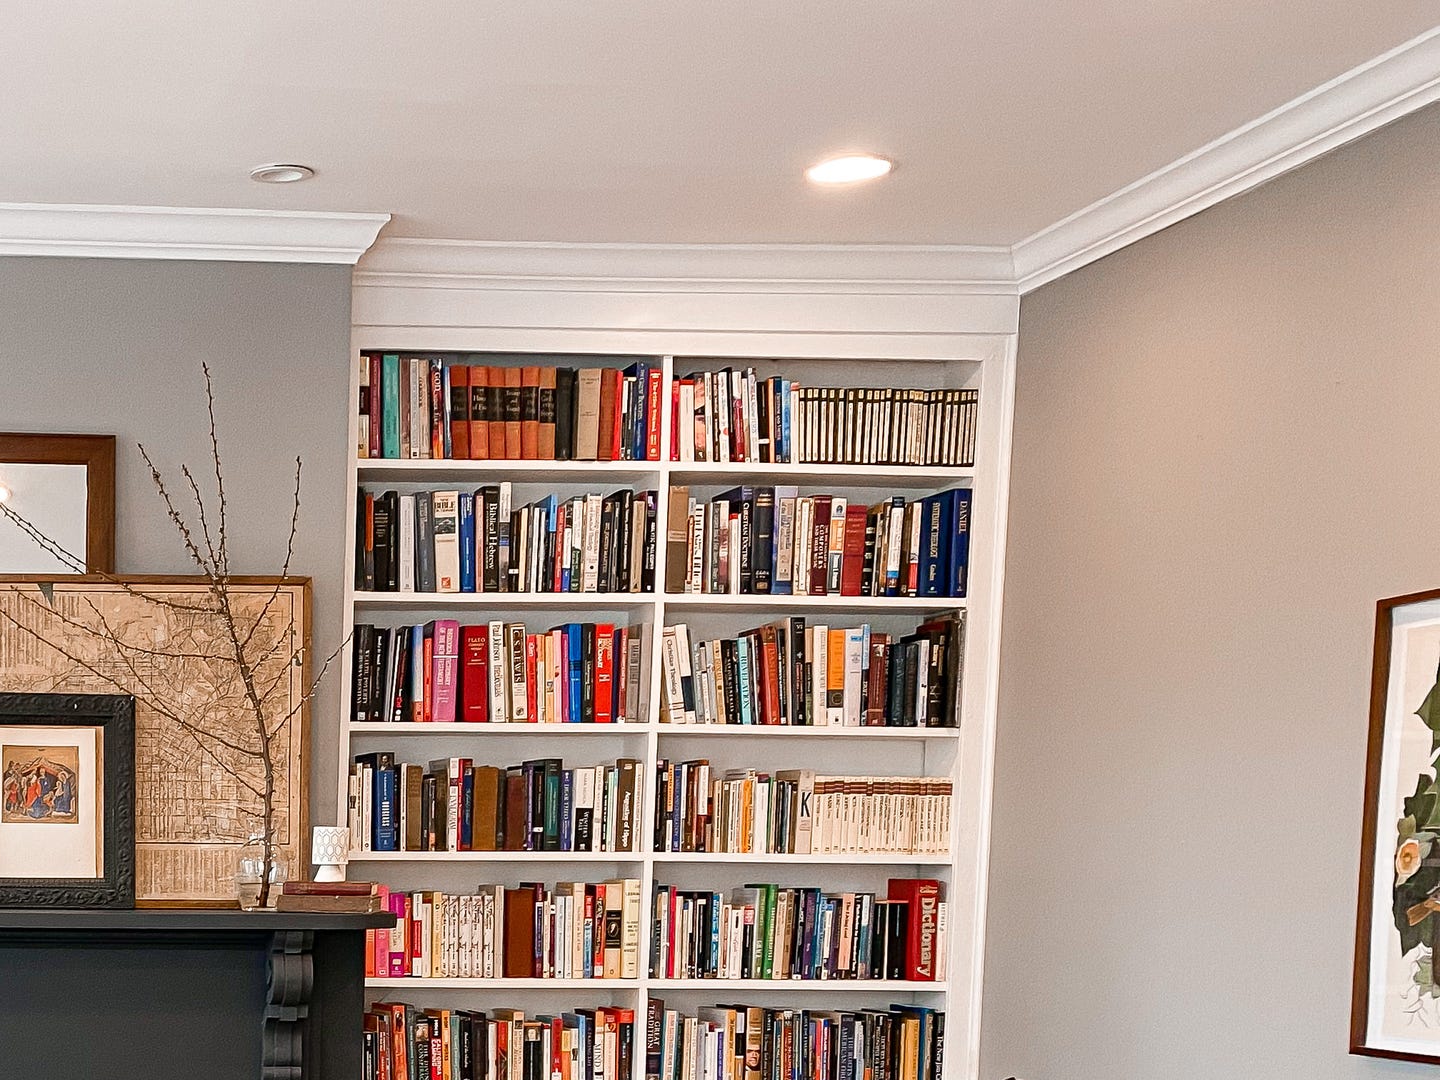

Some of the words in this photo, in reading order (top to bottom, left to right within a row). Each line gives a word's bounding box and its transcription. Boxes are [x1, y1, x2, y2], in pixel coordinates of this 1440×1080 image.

[489, 503, 498, 534] Biblical
[959, 500, 968, 534] DANIEL
[489, 536, 498, 569] Hebrew
[492, 624, 501, 636] Paul
[492, 637, 502, 661] Johnson
[670, 668, 678, 695] Theology
[622, 791, 632, 820] Augustine
[622, 829, 630, 847] Hippo
[918, 897, 935, 976] Dictionary
[647, 1005, 655, 1048] TRADITION
[594, 1043, 602, 1068] MIND
